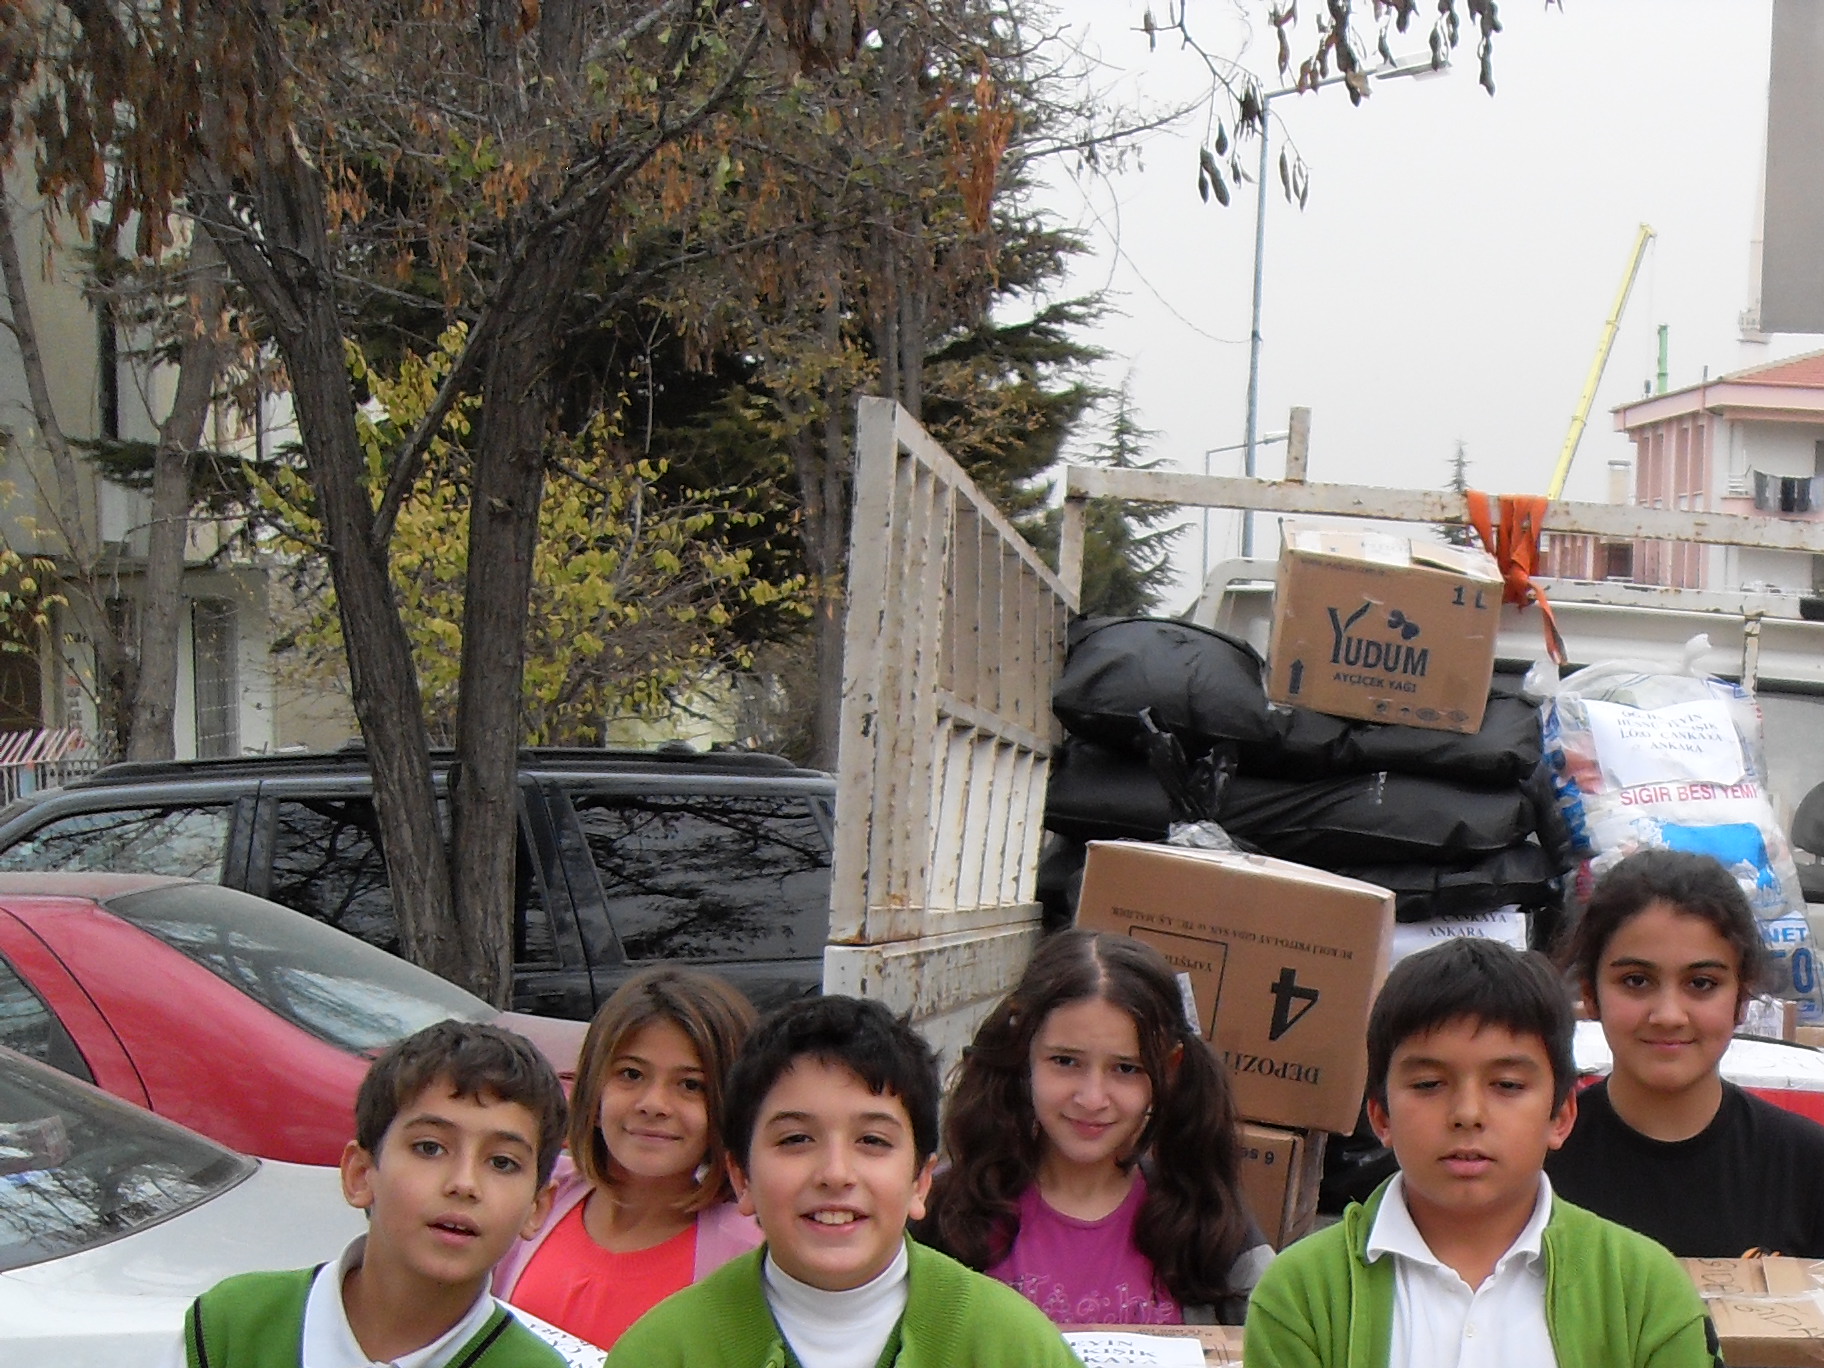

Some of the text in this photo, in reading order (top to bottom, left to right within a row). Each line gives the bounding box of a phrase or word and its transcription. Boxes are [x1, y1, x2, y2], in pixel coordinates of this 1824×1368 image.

[1452, 586, 1488, 610] 1 L
[1269, 967, 1320, 1041] 4
